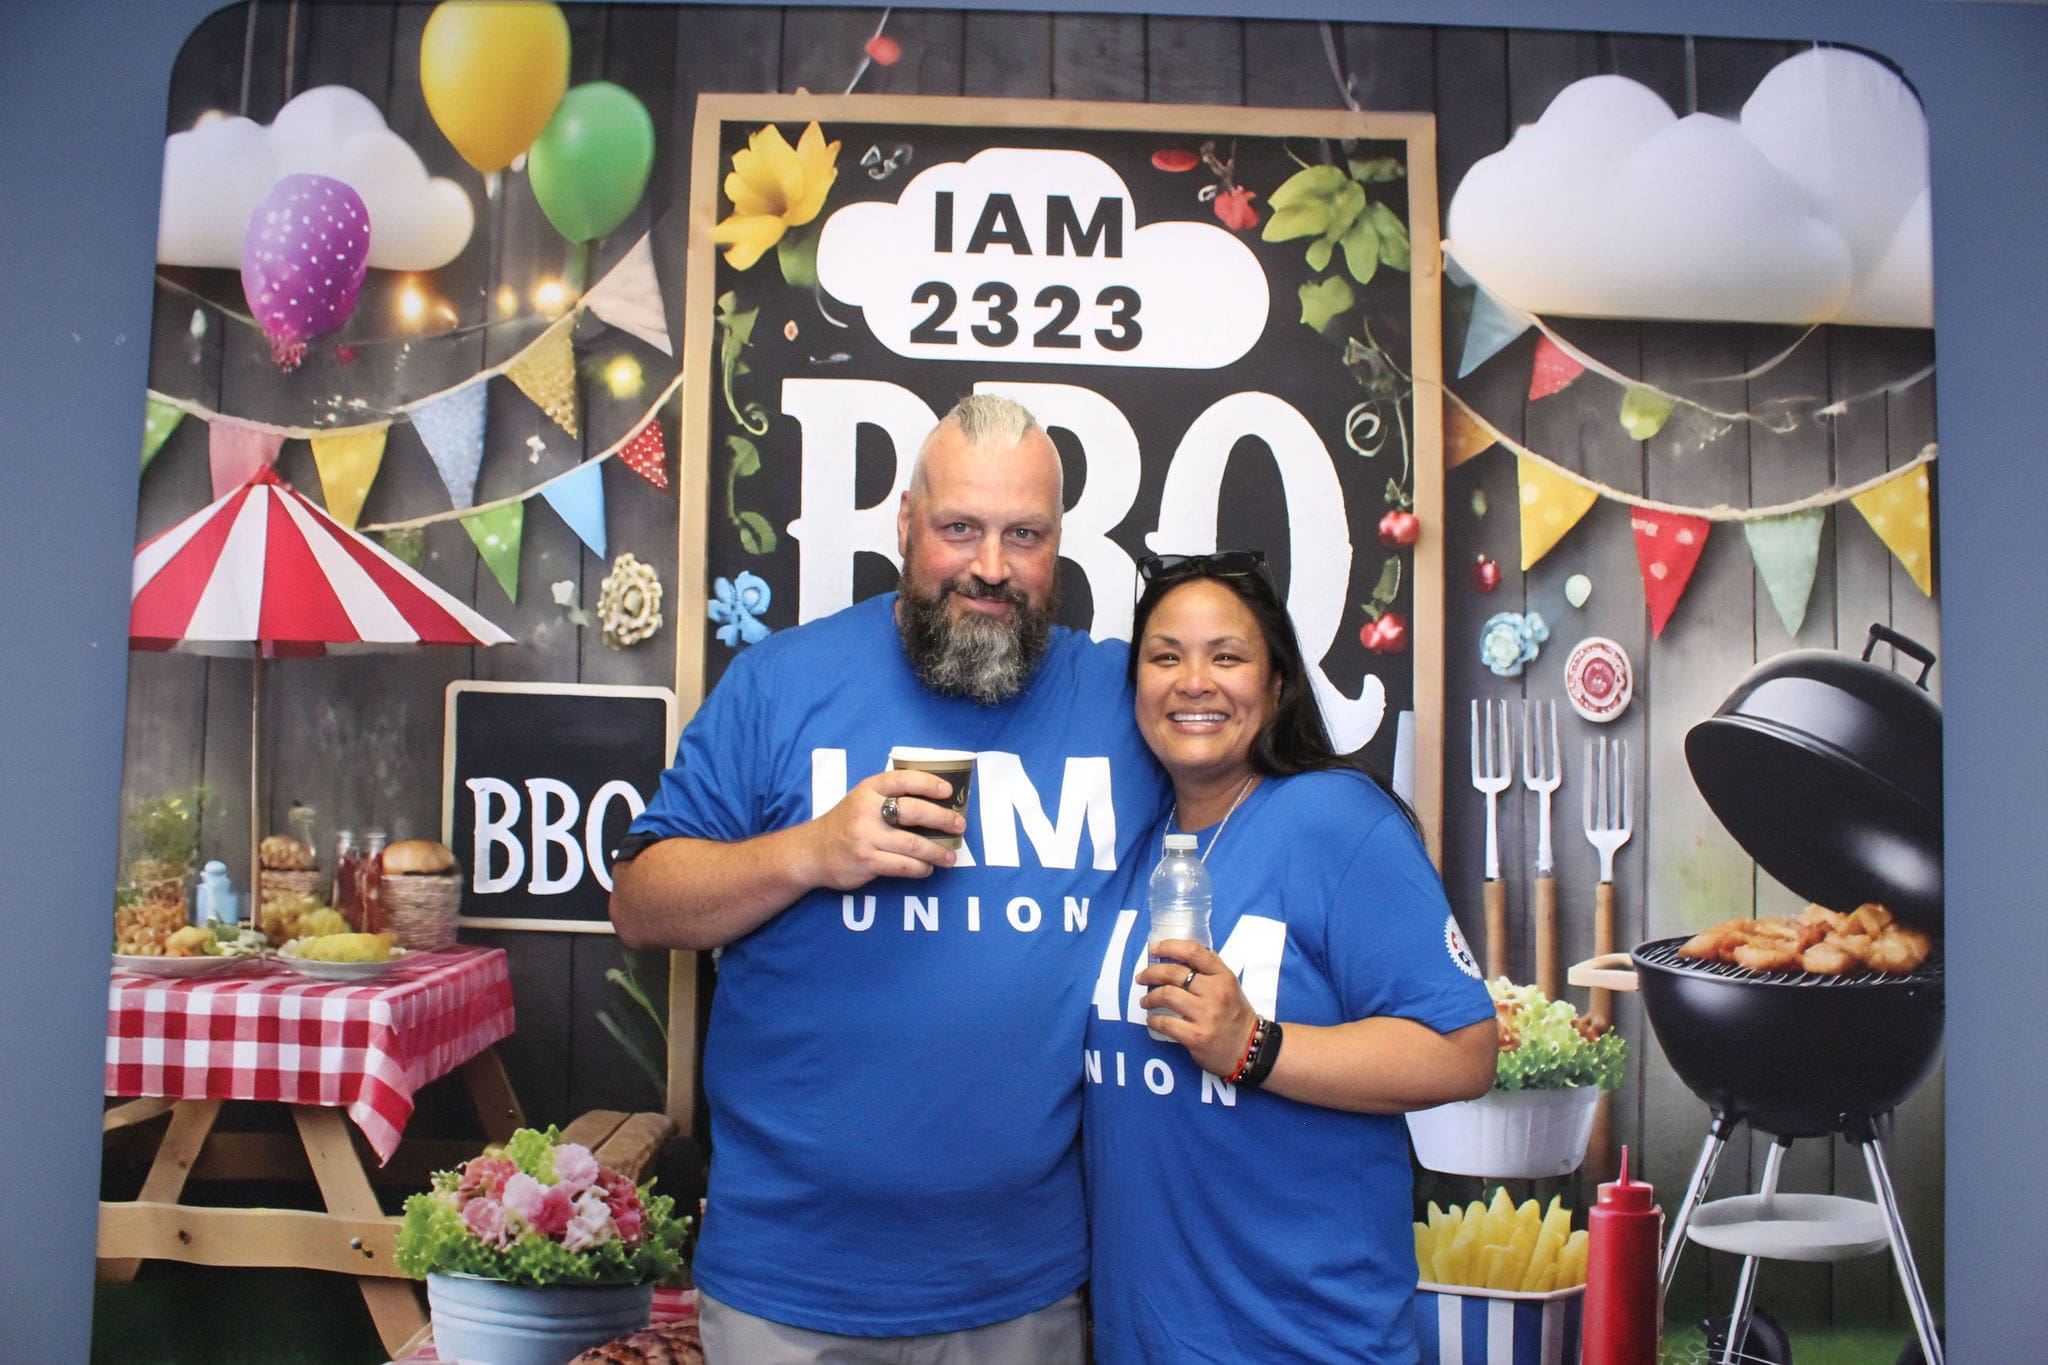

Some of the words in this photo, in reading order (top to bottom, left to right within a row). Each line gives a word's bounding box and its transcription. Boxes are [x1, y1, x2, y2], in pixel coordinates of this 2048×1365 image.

[934, 191, 1123, 258] IAM
[910, 281, 1142, 351] 2323
[811, 747, 1117, 870] IM
[842, 895, 1090, 932] UNION
[1084, 1049, 1237, 1107] NION
